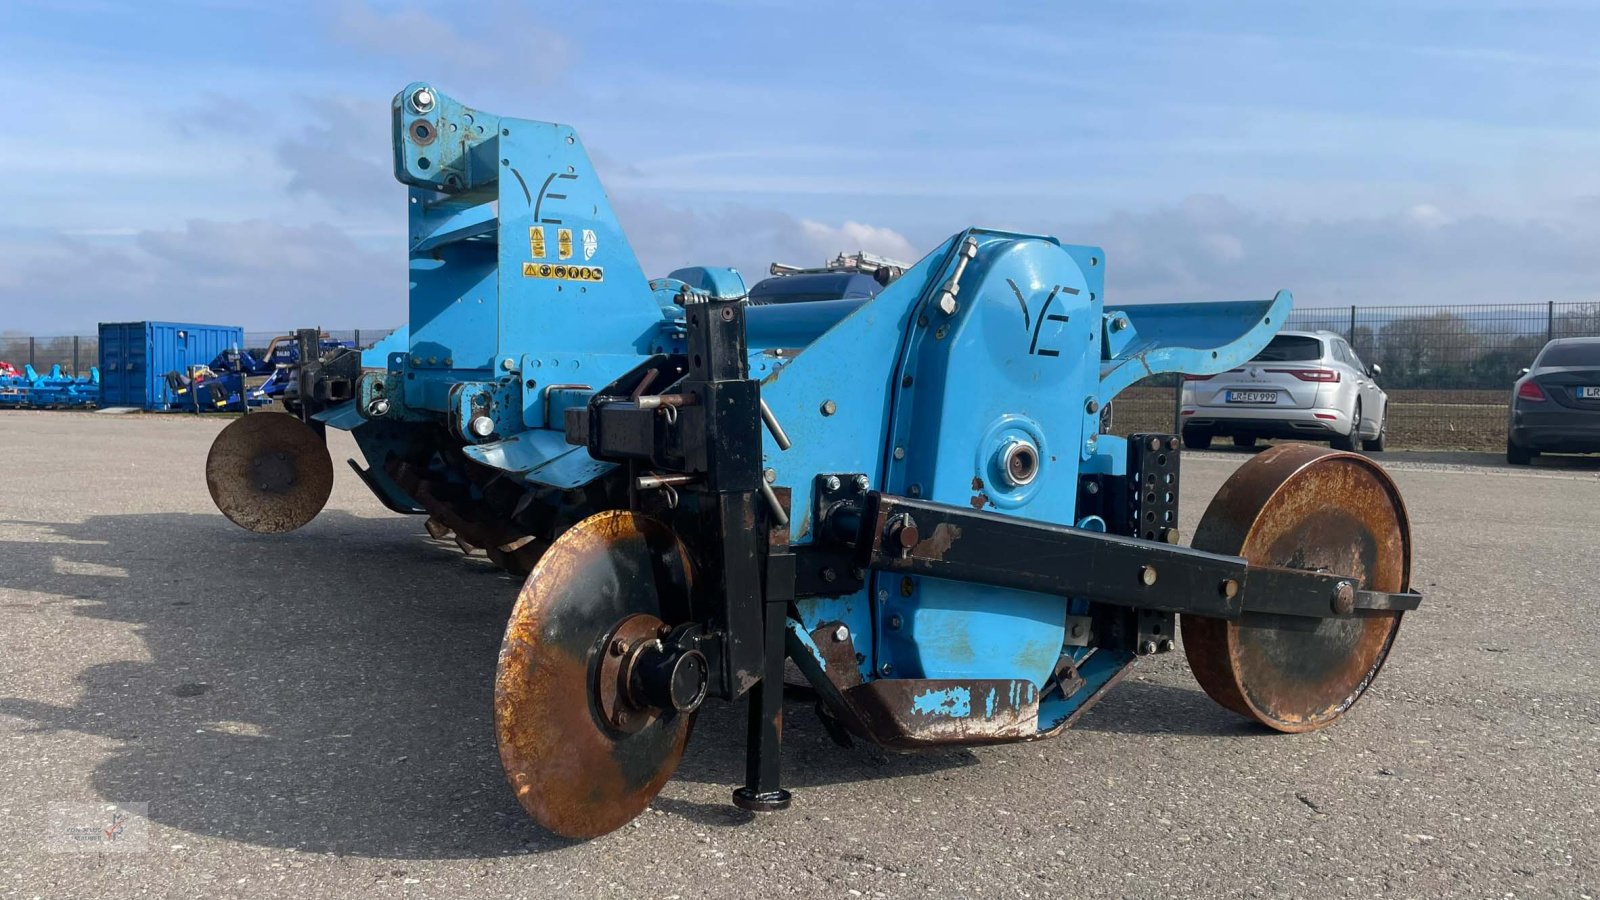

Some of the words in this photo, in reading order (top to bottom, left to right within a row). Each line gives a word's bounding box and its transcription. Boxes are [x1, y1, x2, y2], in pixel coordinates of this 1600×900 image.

[1587, 388, 1600, 396] LR
[1231, 392, 1242, 400] LR
[1247, 392, 1259, 400] EV
[1260, 392, 1276, 401] 999
